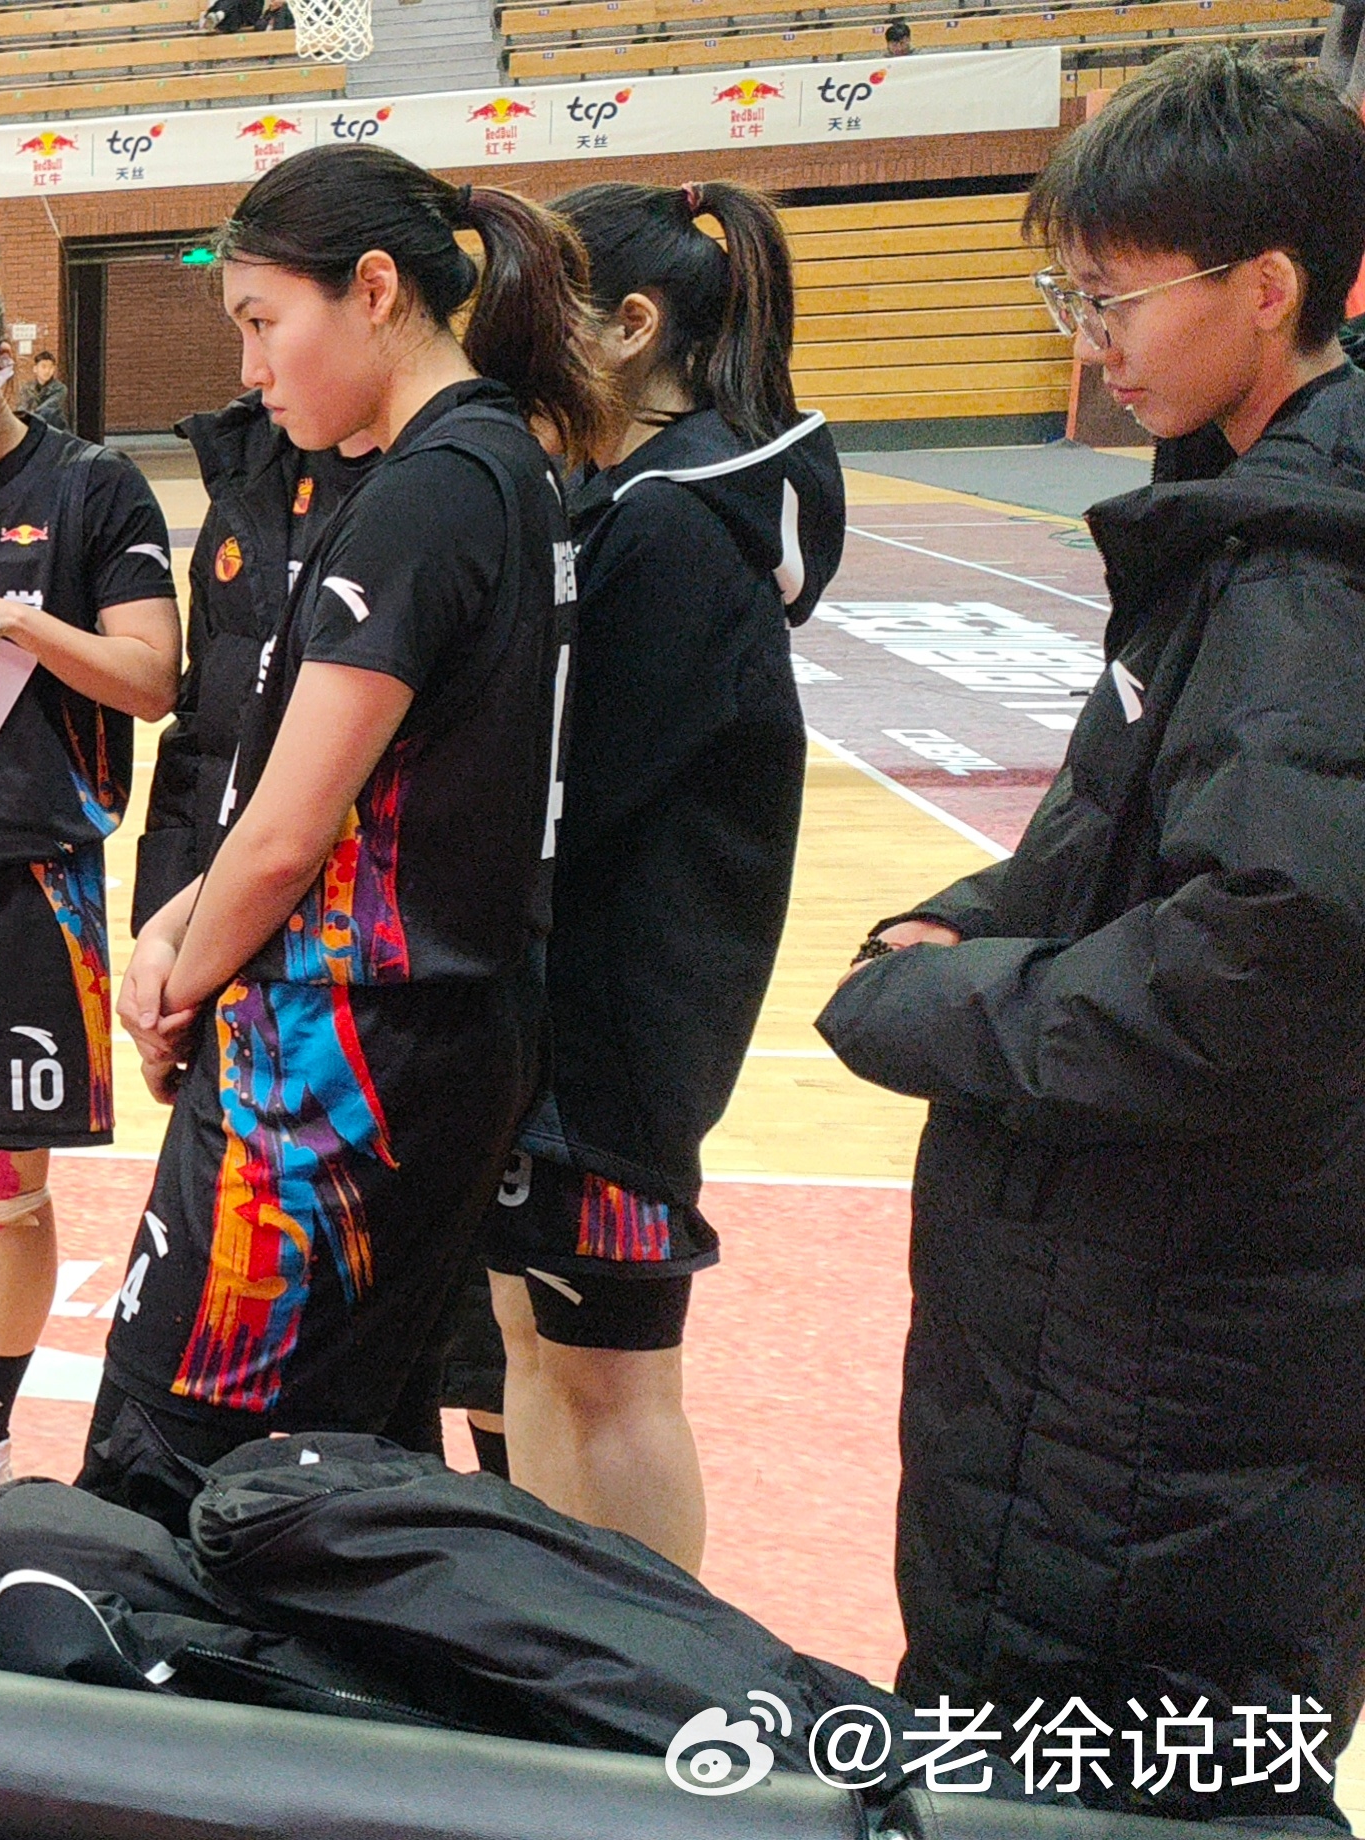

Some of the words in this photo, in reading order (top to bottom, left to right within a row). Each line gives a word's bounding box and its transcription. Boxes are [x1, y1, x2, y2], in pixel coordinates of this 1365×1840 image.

[817, 76, 873, 111] tcp
[566, 96, 618, 129] tcp
[330, 113, 379, 142] tcp
[729, 124, 764, 139] 红牛
[827, 117, 862, 131] 天丝
[106, 129, 153, 161] tcp
[485, 141, 516, 156] 红牛
[576, 134, 609, 149] 天丝
[33, 173, 63, 187] 红牛
[115, 166, 145, 181] 天丝
[11, 1058, 64, 1111] 10
